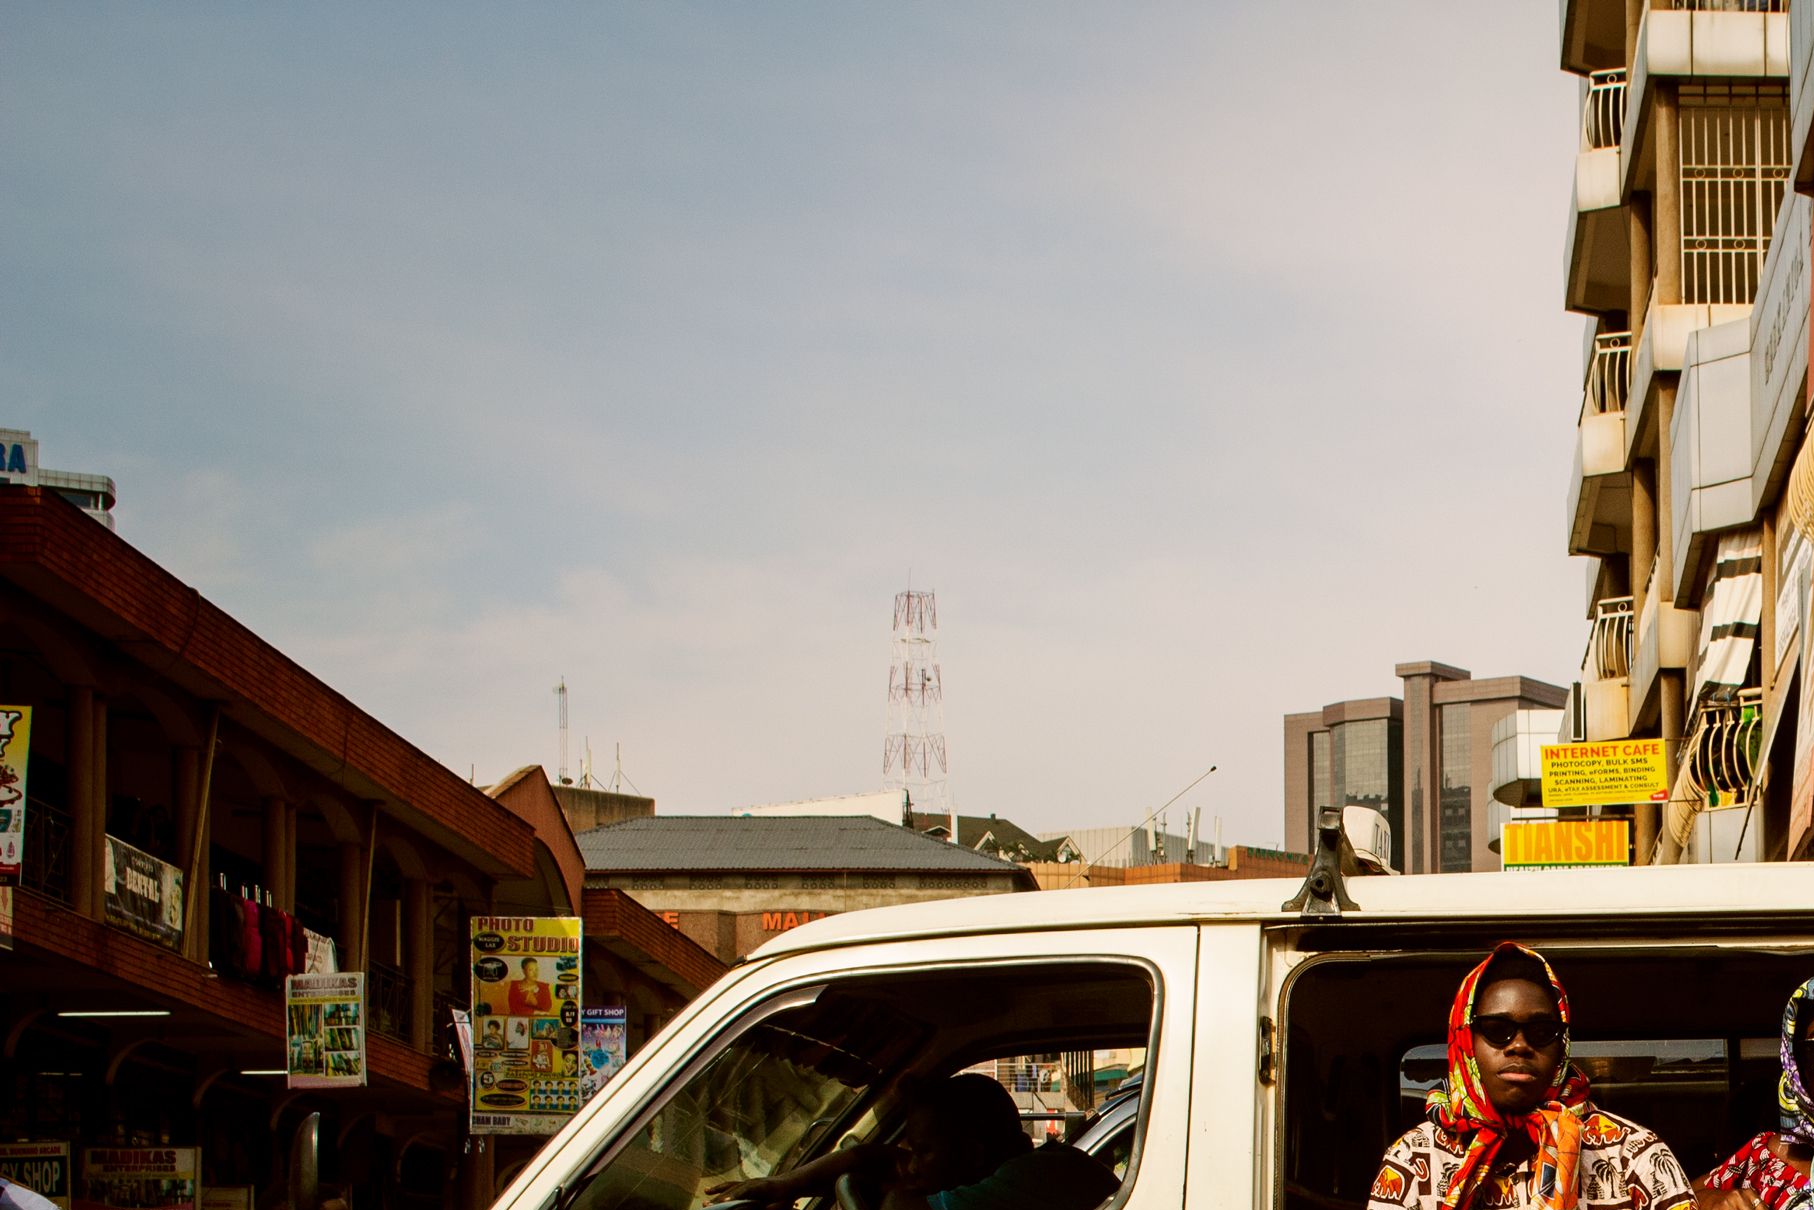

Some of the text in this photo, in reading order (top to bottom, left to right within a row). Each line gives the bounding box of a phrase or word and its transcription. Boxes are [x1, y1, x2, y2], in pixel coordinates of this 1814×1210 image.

[1545, 743, 1660, 760] INTERNET CAFE
[1551, 759, 1604, 769] PHOTOCOPY,
[1606, 758, 1629, 766] BULK
[1549, 769, 1586, 777] PRINTING,
[1623, 766, 1655, 774] BINDING
[1554, 775, 1648, 786] SCANNING, LAMINATING
[1504, 821, 1626, 862] TIANSHI
[125, 867, 160, 903] DENTAL
[477, 918, 534, 931] PHOTO
[507, 936, 579, 953] STUDIO
[587, 1008, 603, 1016] GIFT
[604, 1008, 624, 1016] SHOP
[91, 1150, 176, 1164] MADIKAS
[23, 1160, 60, 1194] SHOP
